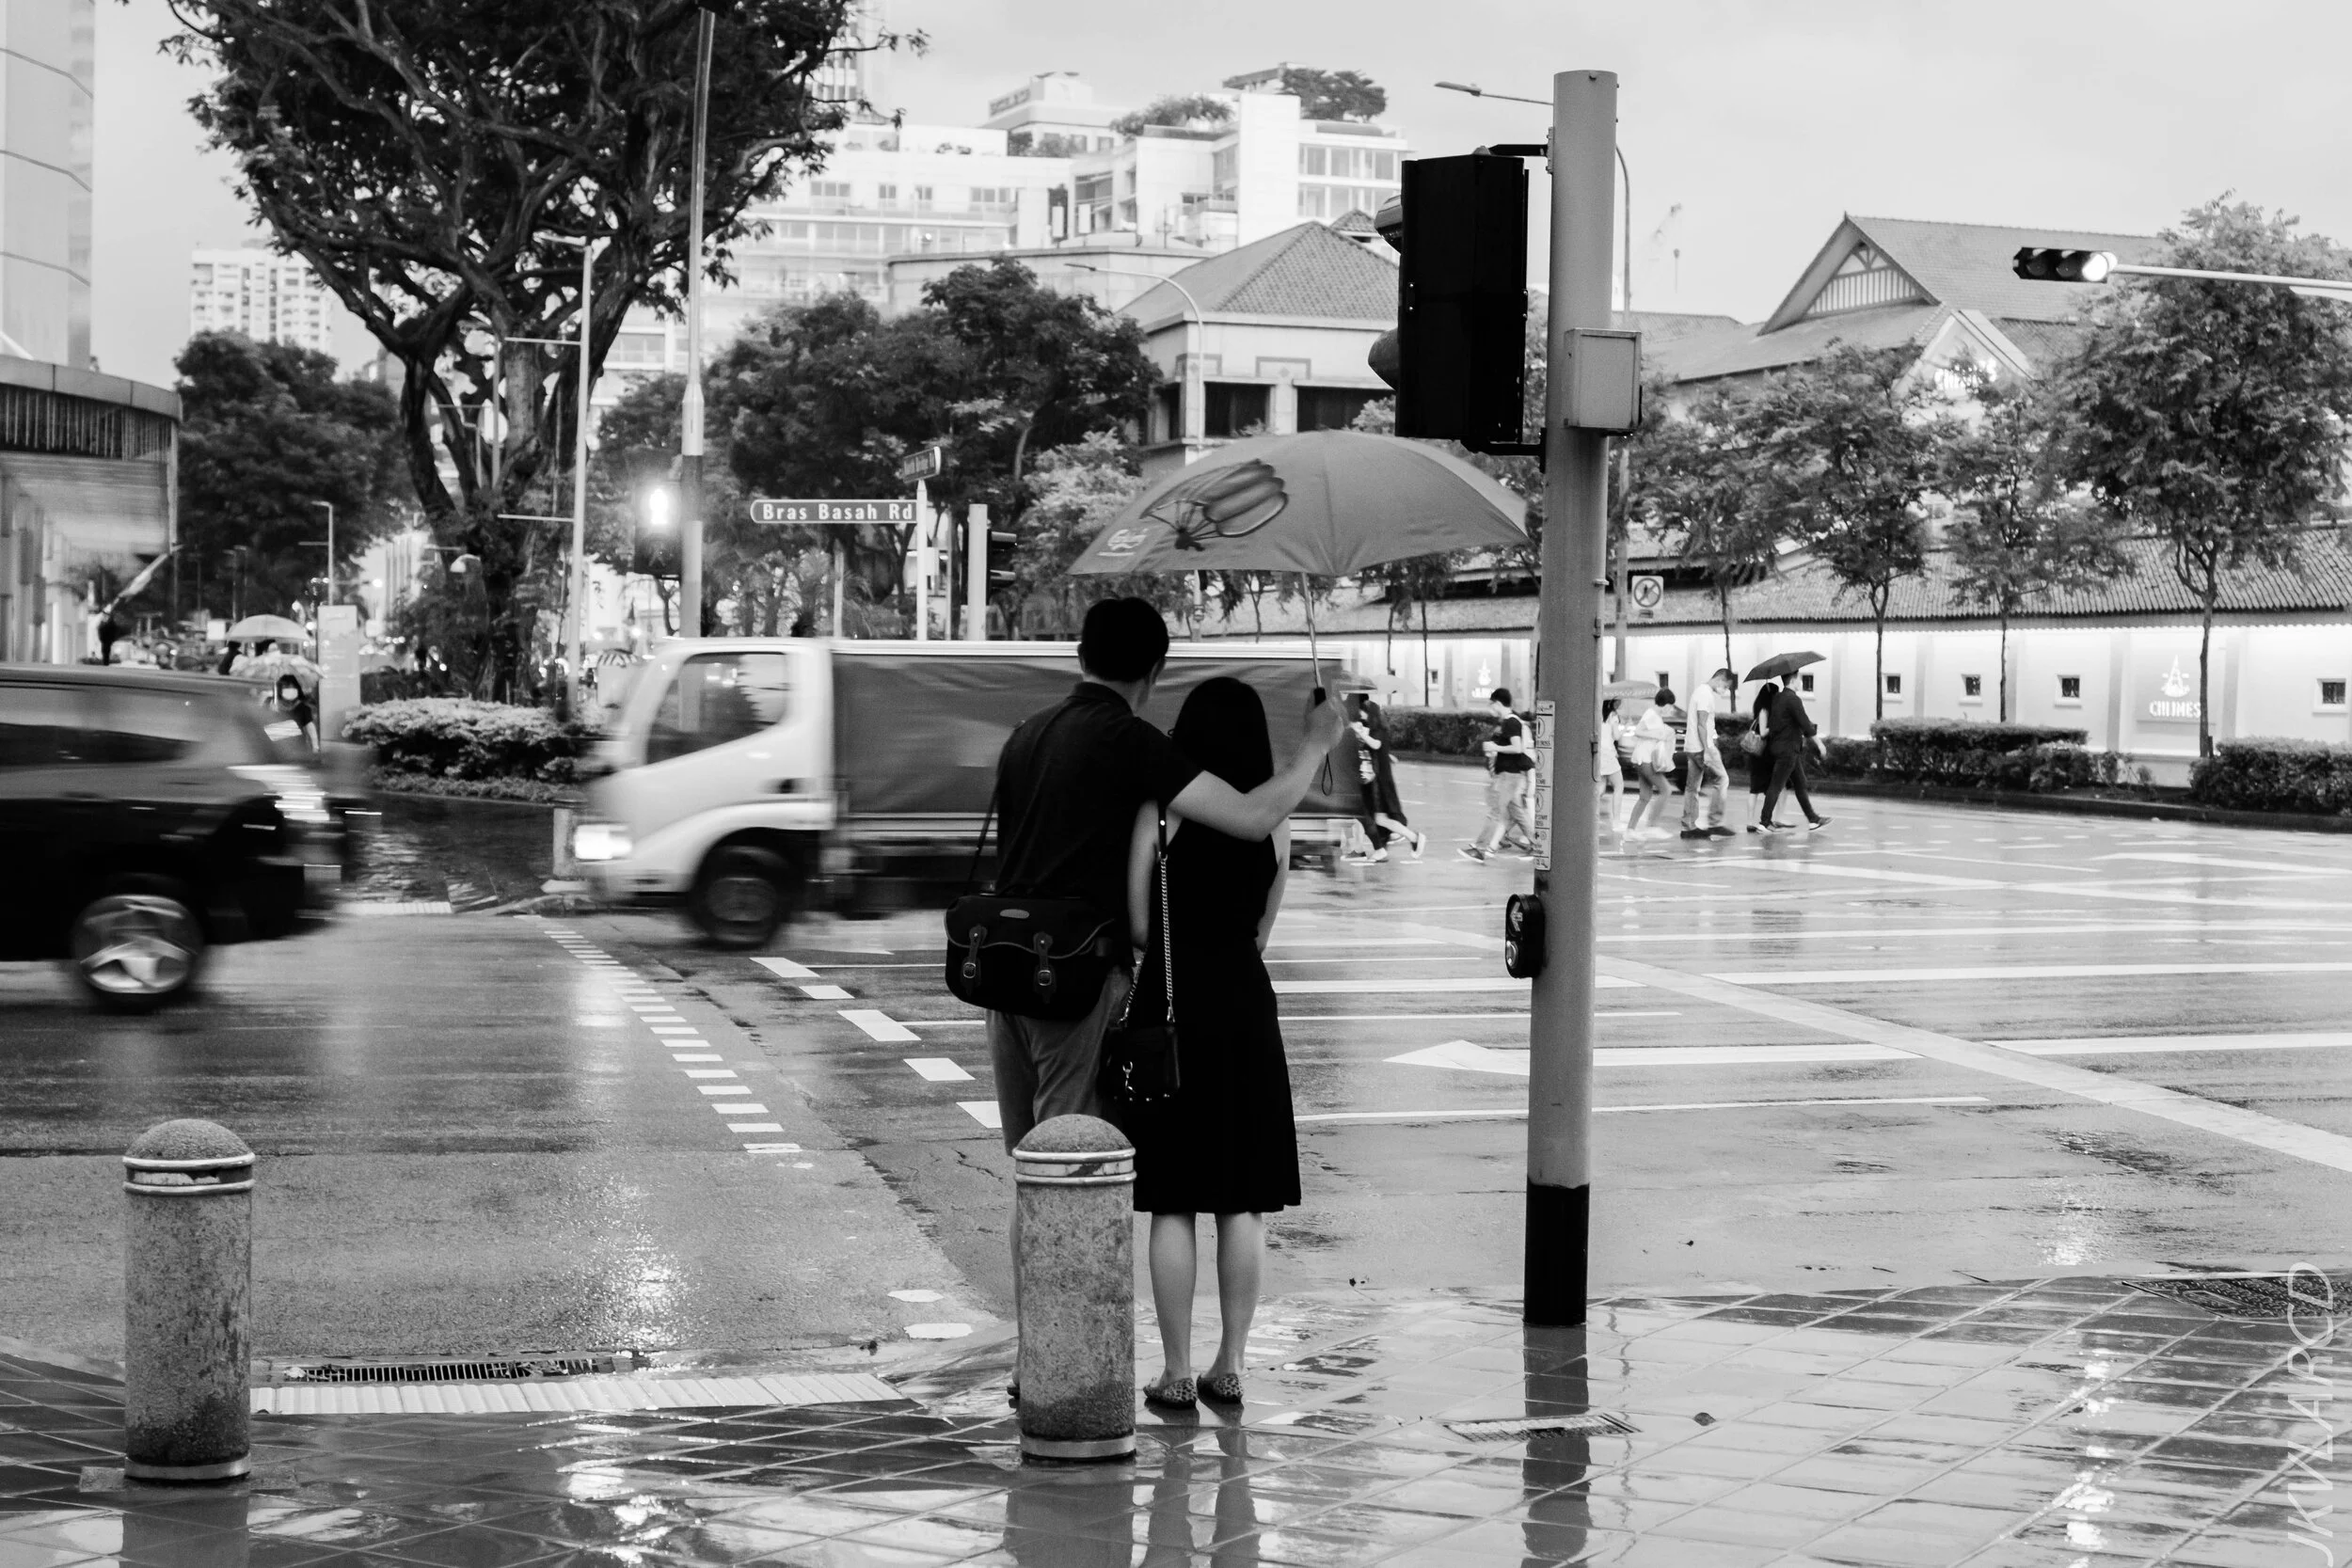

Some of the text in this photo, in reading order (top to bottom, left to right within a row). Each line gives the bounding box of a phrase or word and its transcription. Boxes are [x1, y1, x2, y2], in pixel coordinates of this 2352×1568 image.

[763, 503, 913, 520] Bras Basah Rd
